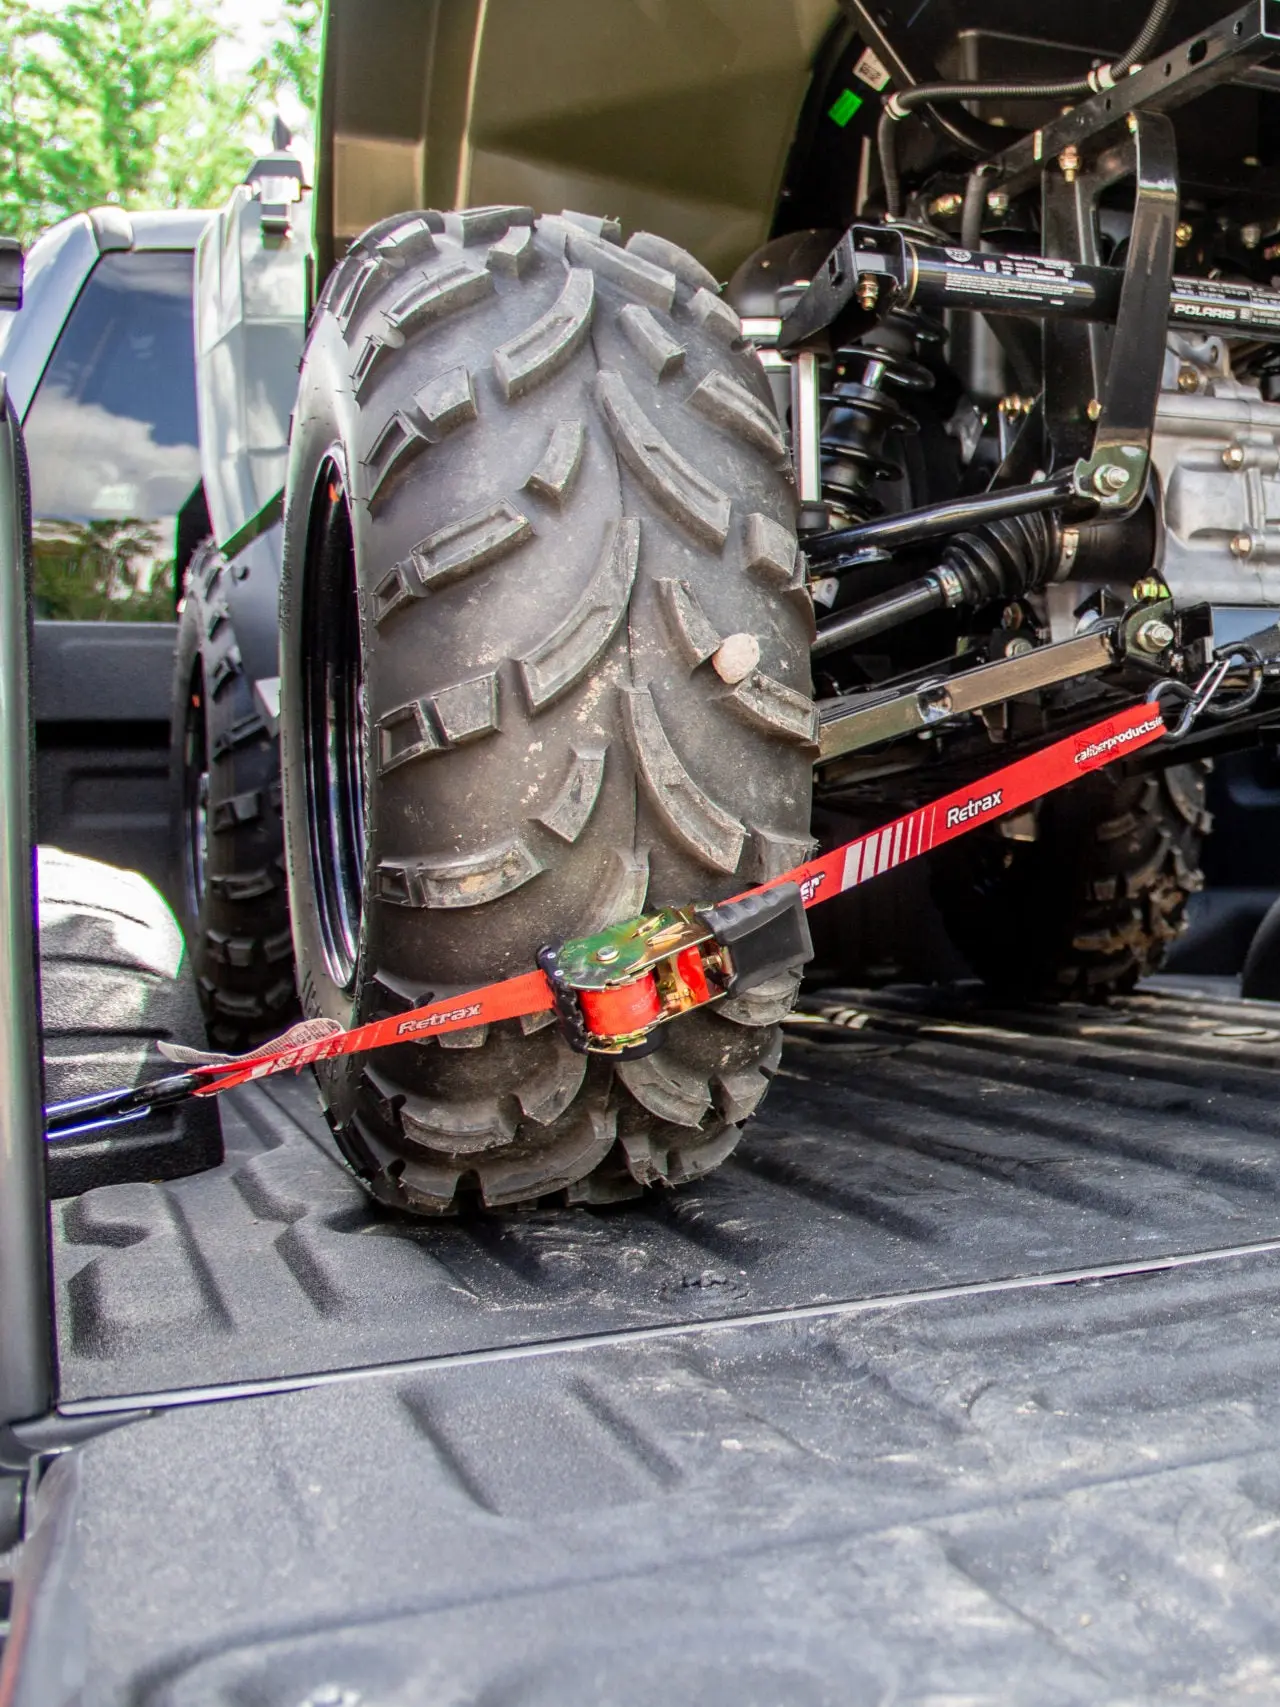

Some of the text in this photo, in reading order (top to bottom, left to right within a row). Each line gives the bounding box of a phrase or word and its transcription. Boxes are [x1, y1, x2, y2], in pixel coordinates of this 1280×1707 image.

[1174, 303, 1236, 320] POLARIS
[946, 789, 1003, 828] Retrax
[397, 1002, 484, 1036] Retrax
